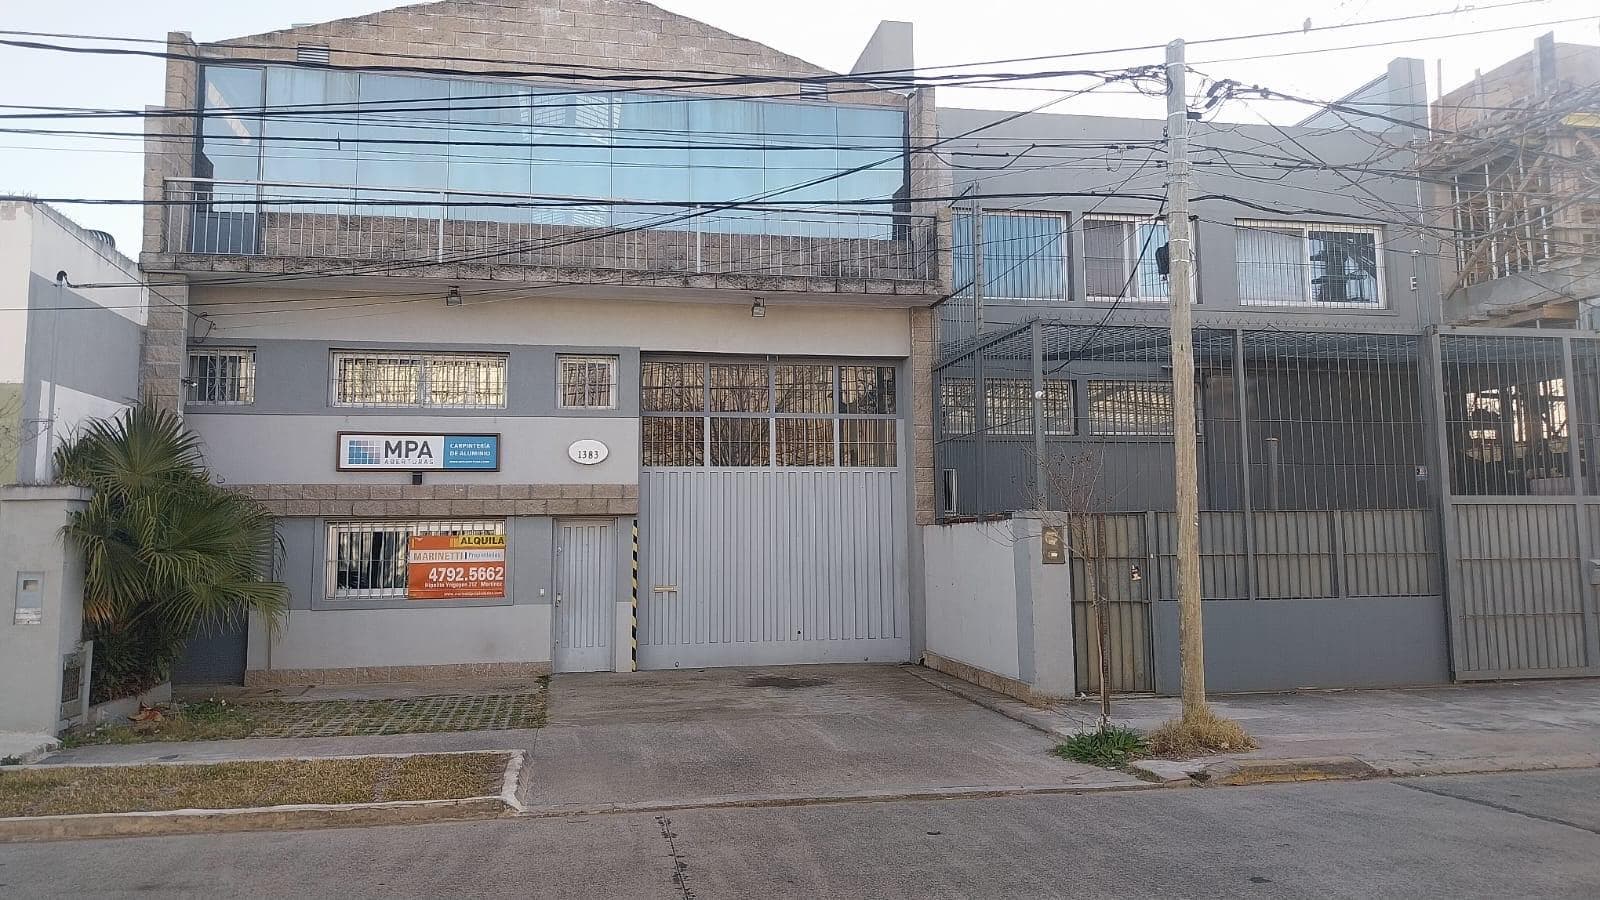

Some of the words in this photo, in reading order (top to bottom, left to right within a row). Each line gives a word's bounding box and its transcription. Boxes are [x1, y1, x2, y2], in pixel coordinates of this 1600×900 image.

[384, 440, 433, 458] MPA
[578, 450, 599, 459] 1383
[460, 536, 505, 545] ALQUILA
[413, 552, 463, 561] MARINETTI
[428, 566, 504, 582] 4792.5662
